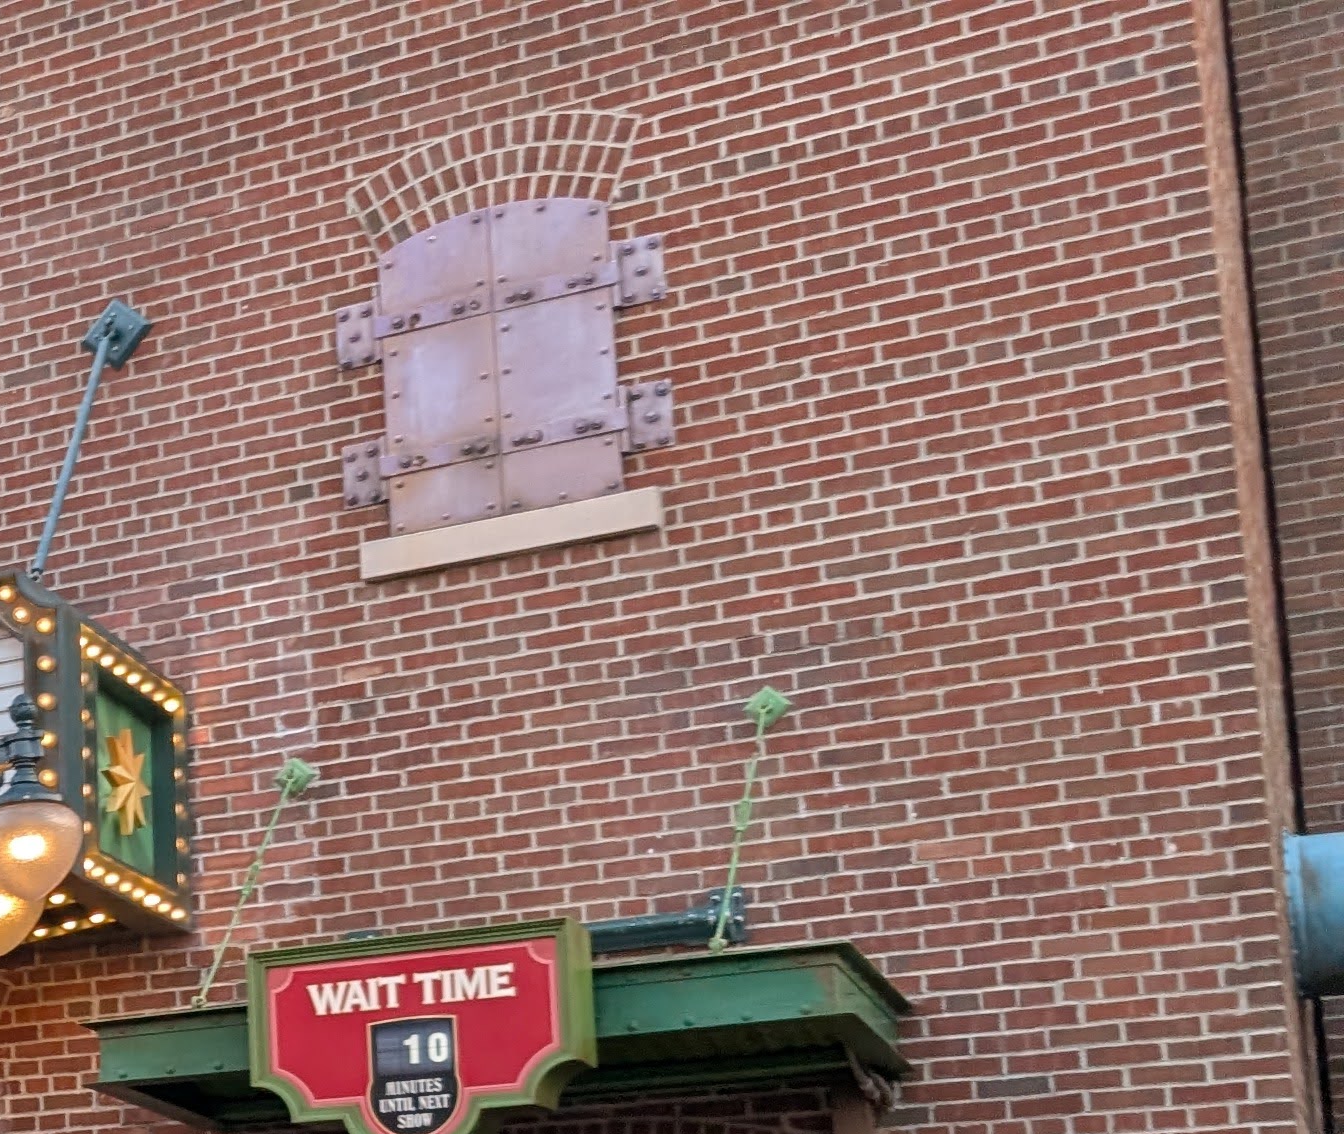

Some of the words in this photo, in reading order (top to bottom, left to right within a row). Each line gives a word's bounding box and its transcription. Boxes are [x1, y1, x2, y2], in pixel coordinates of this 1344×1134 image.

[306, 973, 407, 1016] WAIT
[412, 962, 517, 1005] TIME
[402, 1031, 449, 1065] 10
[385, 1077, 443, 1096] MINUTES
[378, 1096, 416, 1113] UNTIL
[418, 1094, 452, 1111] NEXT
[397, 1113, 433, 1129] SHOW
